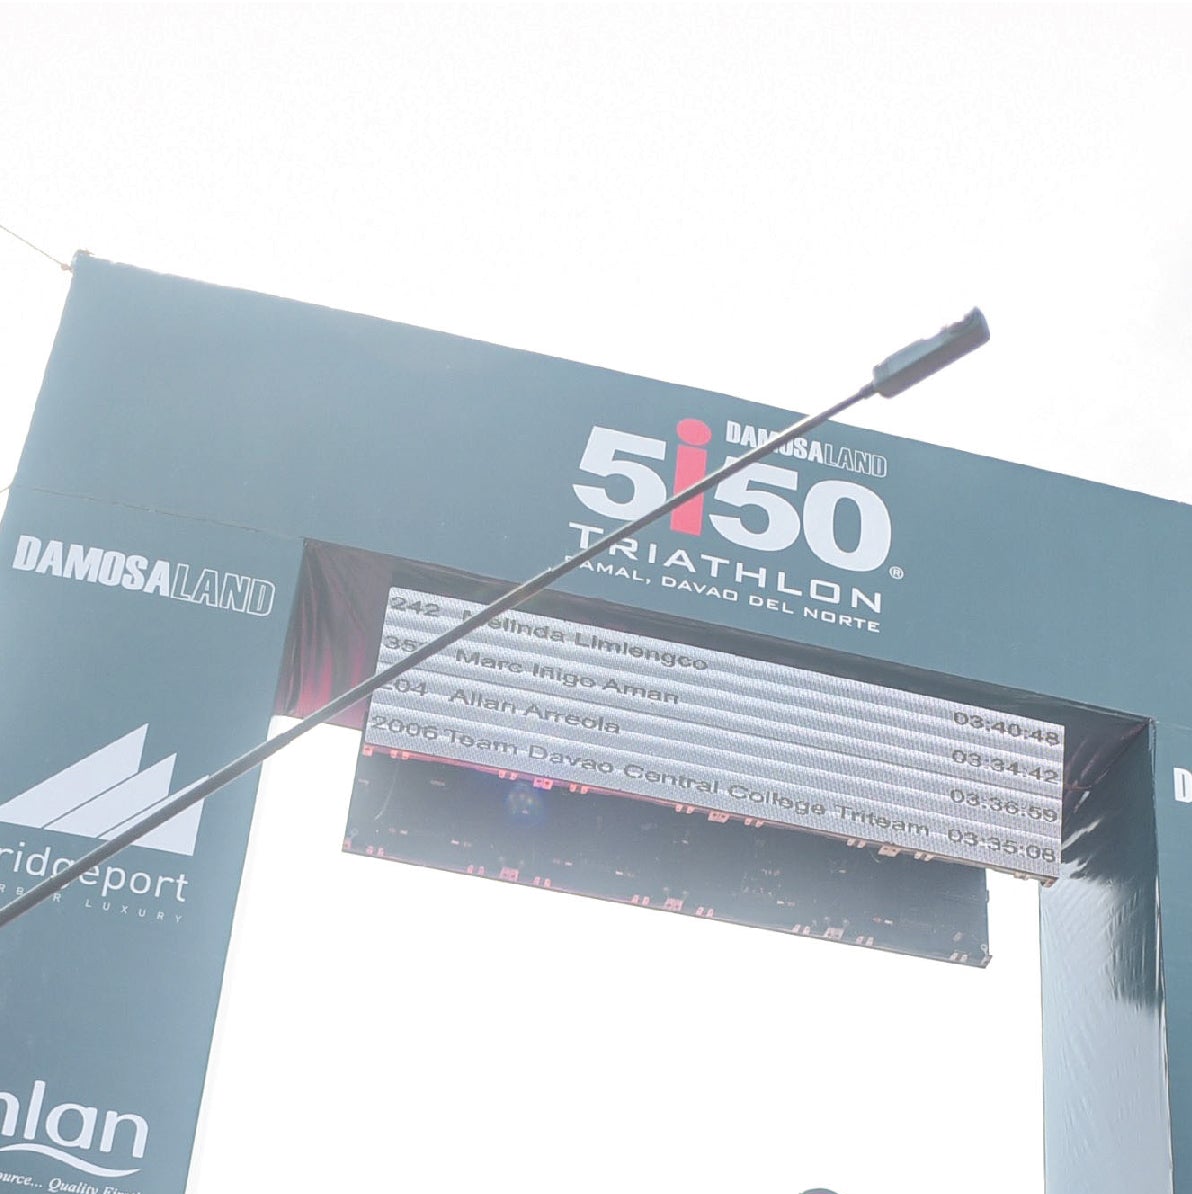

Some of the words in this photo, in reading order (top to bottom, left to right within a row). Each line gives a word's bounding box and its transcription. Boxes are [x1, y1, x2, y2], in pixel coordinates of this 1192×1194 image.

[12, 535, 276, 617] DAMOSALAND
[568, 522, 881, 613] TRIATHLON
[661, 575, 738, 602] DAVAO
[749, 595, 794, 615] DEL
[804, 606, 881, 633] NORTE
[382, 635, 429, 655] 35
[455, 649, 523, 673] Marc
[602, 677, 680, 705] Aman
[952, 750, 1058, 785] 03:34:42
[390, 596, 441, 617] 242
[954, 712, 1060, 746] 03:40:48
[371, 715, 438, 741] 2006
[441, 728, 518, 756] Team
[528, 744, 615, 774] Davao
[623, 762, 719, 795] Central
[727, 784, 826, 818] College
[834, 804, 930, 837] Triteam
[948, 828, 1055, 862] 03:35:08
[449, 688, 517, 715] Allan
[521, 701, 621, 735] Arreola
[951, 788, 1057, 822] 03:36:59
[85, 898, 183, 924] LUXURY
